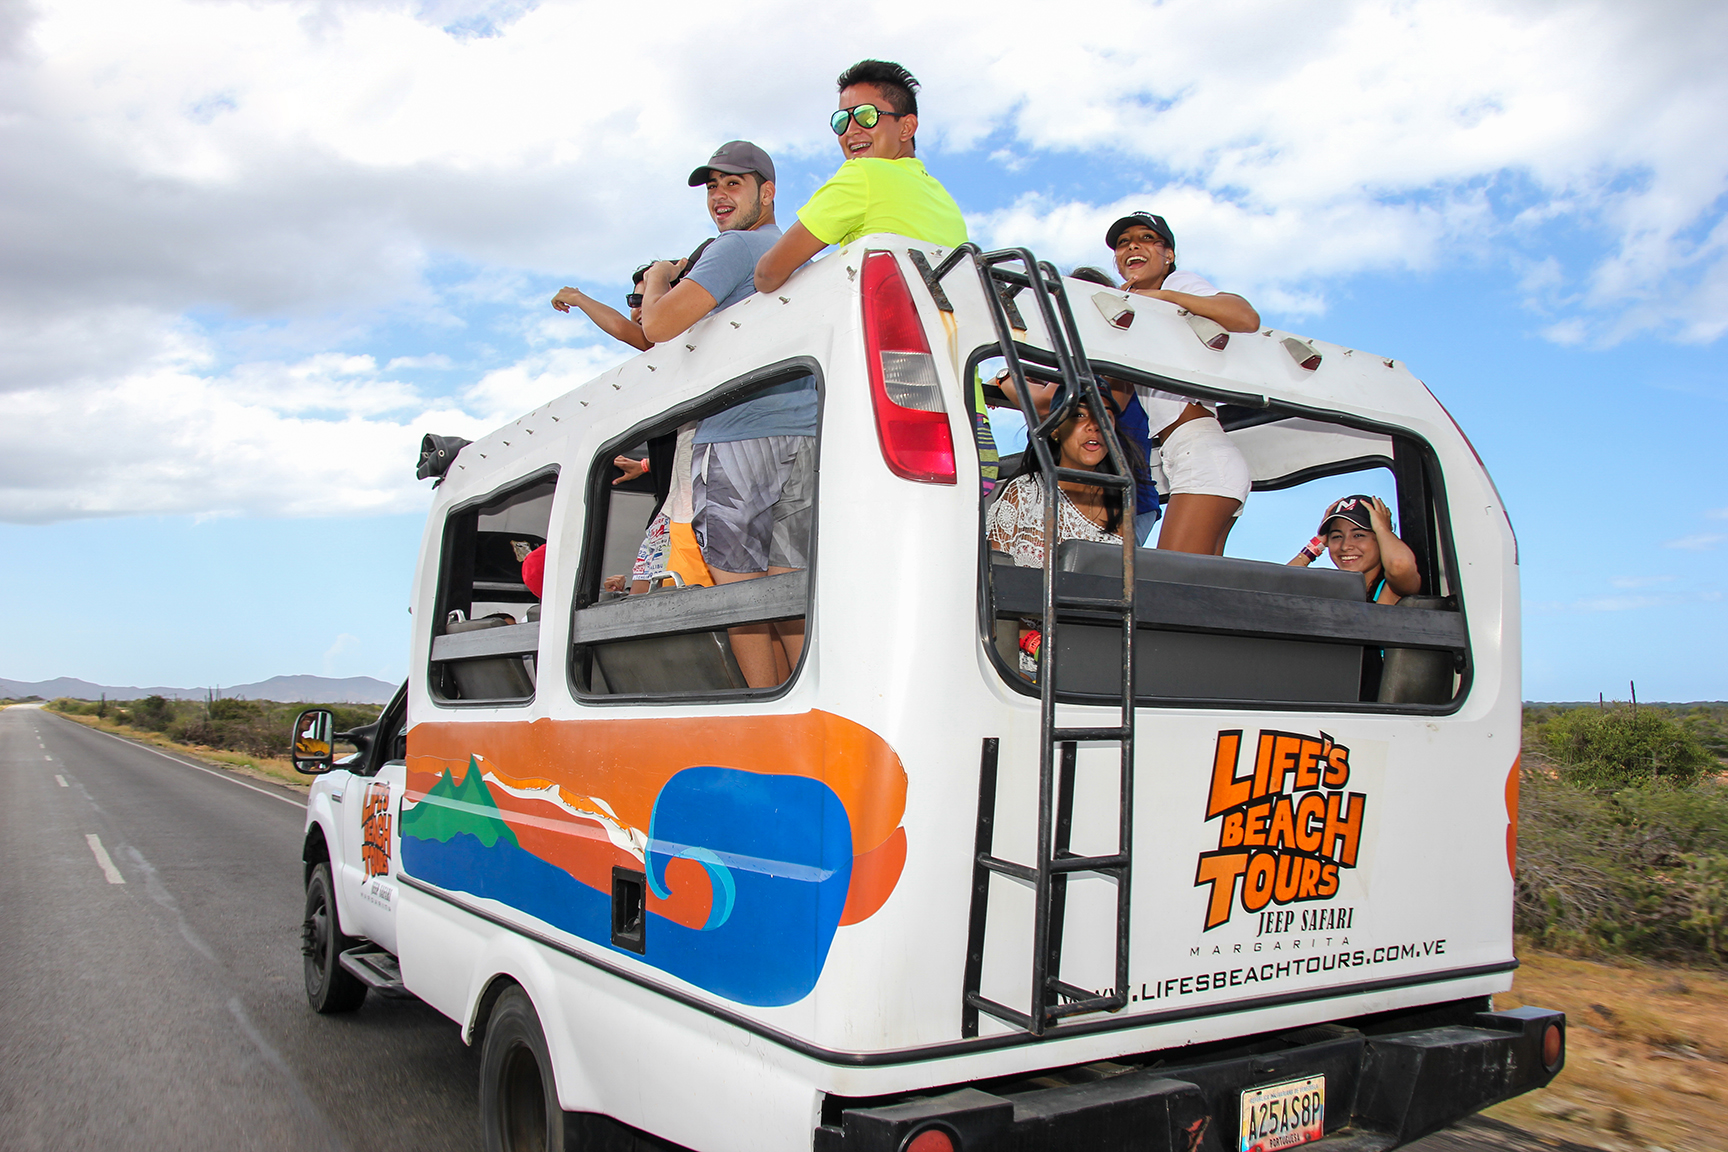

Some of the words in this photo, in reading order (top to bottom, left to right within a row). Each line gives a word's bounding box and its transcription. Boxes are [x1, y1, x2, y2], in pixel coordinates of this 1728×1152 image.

[1204, 729, 1351, 823] LIFE'S
[1218, 791, 1367, 869] BEACH
[1194, 849, 1340, 933] TOURS
[1256, 910, 1295, 938] JEEP
[1301, 907, 1354, 932] SAFARI
[1060, 939, 1447, 1006] .LIFESBEACHTOURS.COM.VE
[1189, 936, 1350, 957] MARGARITA
[1248, 1091, 1320, 1141] A25AS8P
